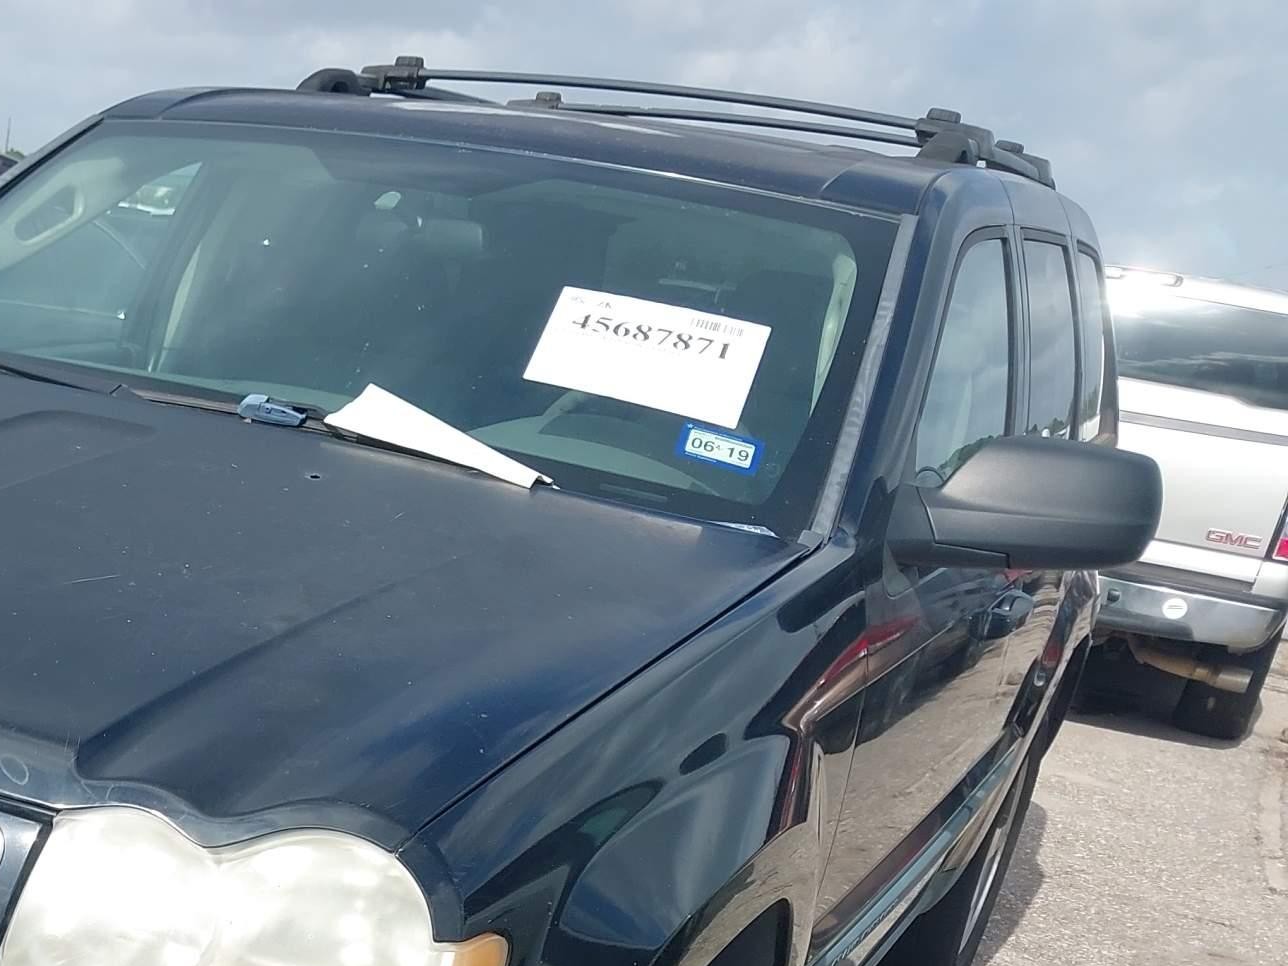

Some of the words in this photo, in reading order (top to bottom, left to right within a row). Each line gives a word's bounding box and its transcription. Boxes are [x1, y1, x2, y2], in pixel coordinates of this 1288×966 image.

[572, 313, 731, 361] 45687871
[691, 437, 715, 453] 06
[727, 447, 750, 462] 19
[1205, 529, 1263, 550] GMC
